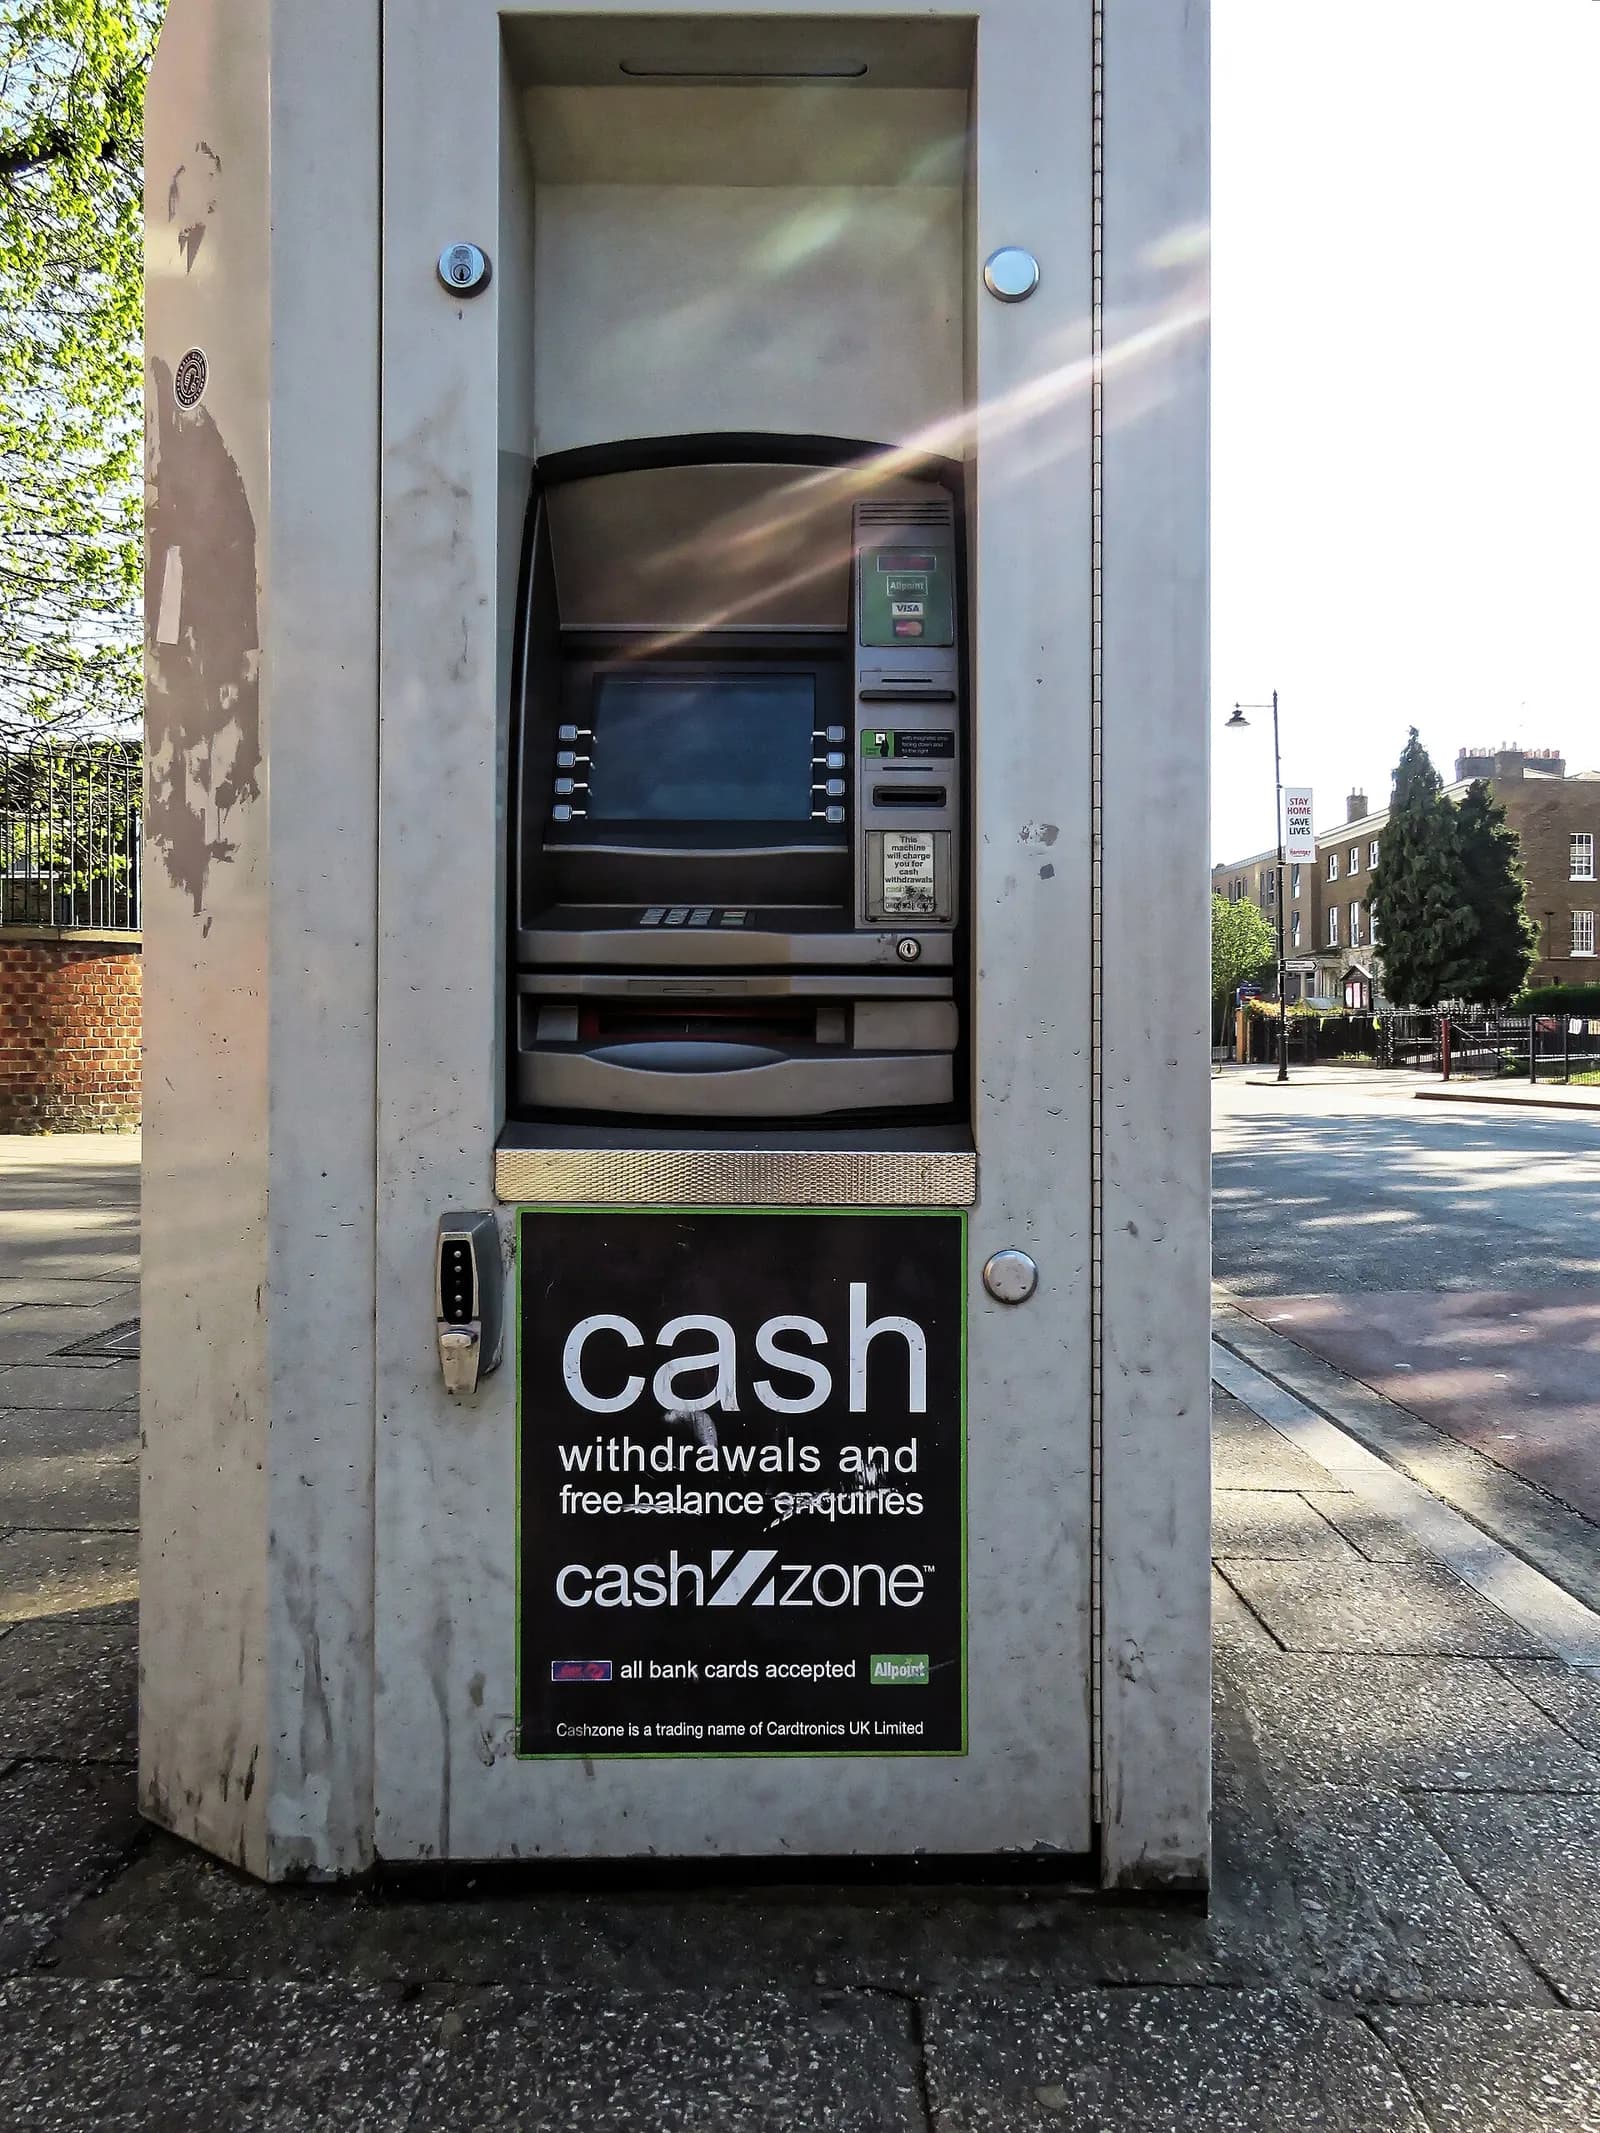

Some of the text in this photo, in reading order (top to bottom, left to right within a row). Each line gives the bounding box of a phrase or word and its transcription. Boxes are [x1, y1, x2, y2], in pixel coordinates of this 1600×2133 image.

[896, 604, 920, 612] VISA
[1287, 807, 1311, 815] HOME
[1289, 818, 1310, 826] SAVE
[1289, 827, 1311, 835] LIVES
[902, 852, 931, 860] charge
[895, 861, 909, 869] you
[562, 1282, 927, 1413] cash
[559, 1437, 916, 1473] withdrawals and
[560, 1484, 924, 1522] free balance enquiries
[620, 1660, 643, 1679] all
[650, 1660, 699, 1679] bank
[704, 1660, 759, 1679] cards
[766, 1660, 856, 1683] accepted
[874, 1661, 925, 1680] Allpoint
[556, 1721, 924, 1739] Cashzone is a trading name of Cardtronics UK Limited
